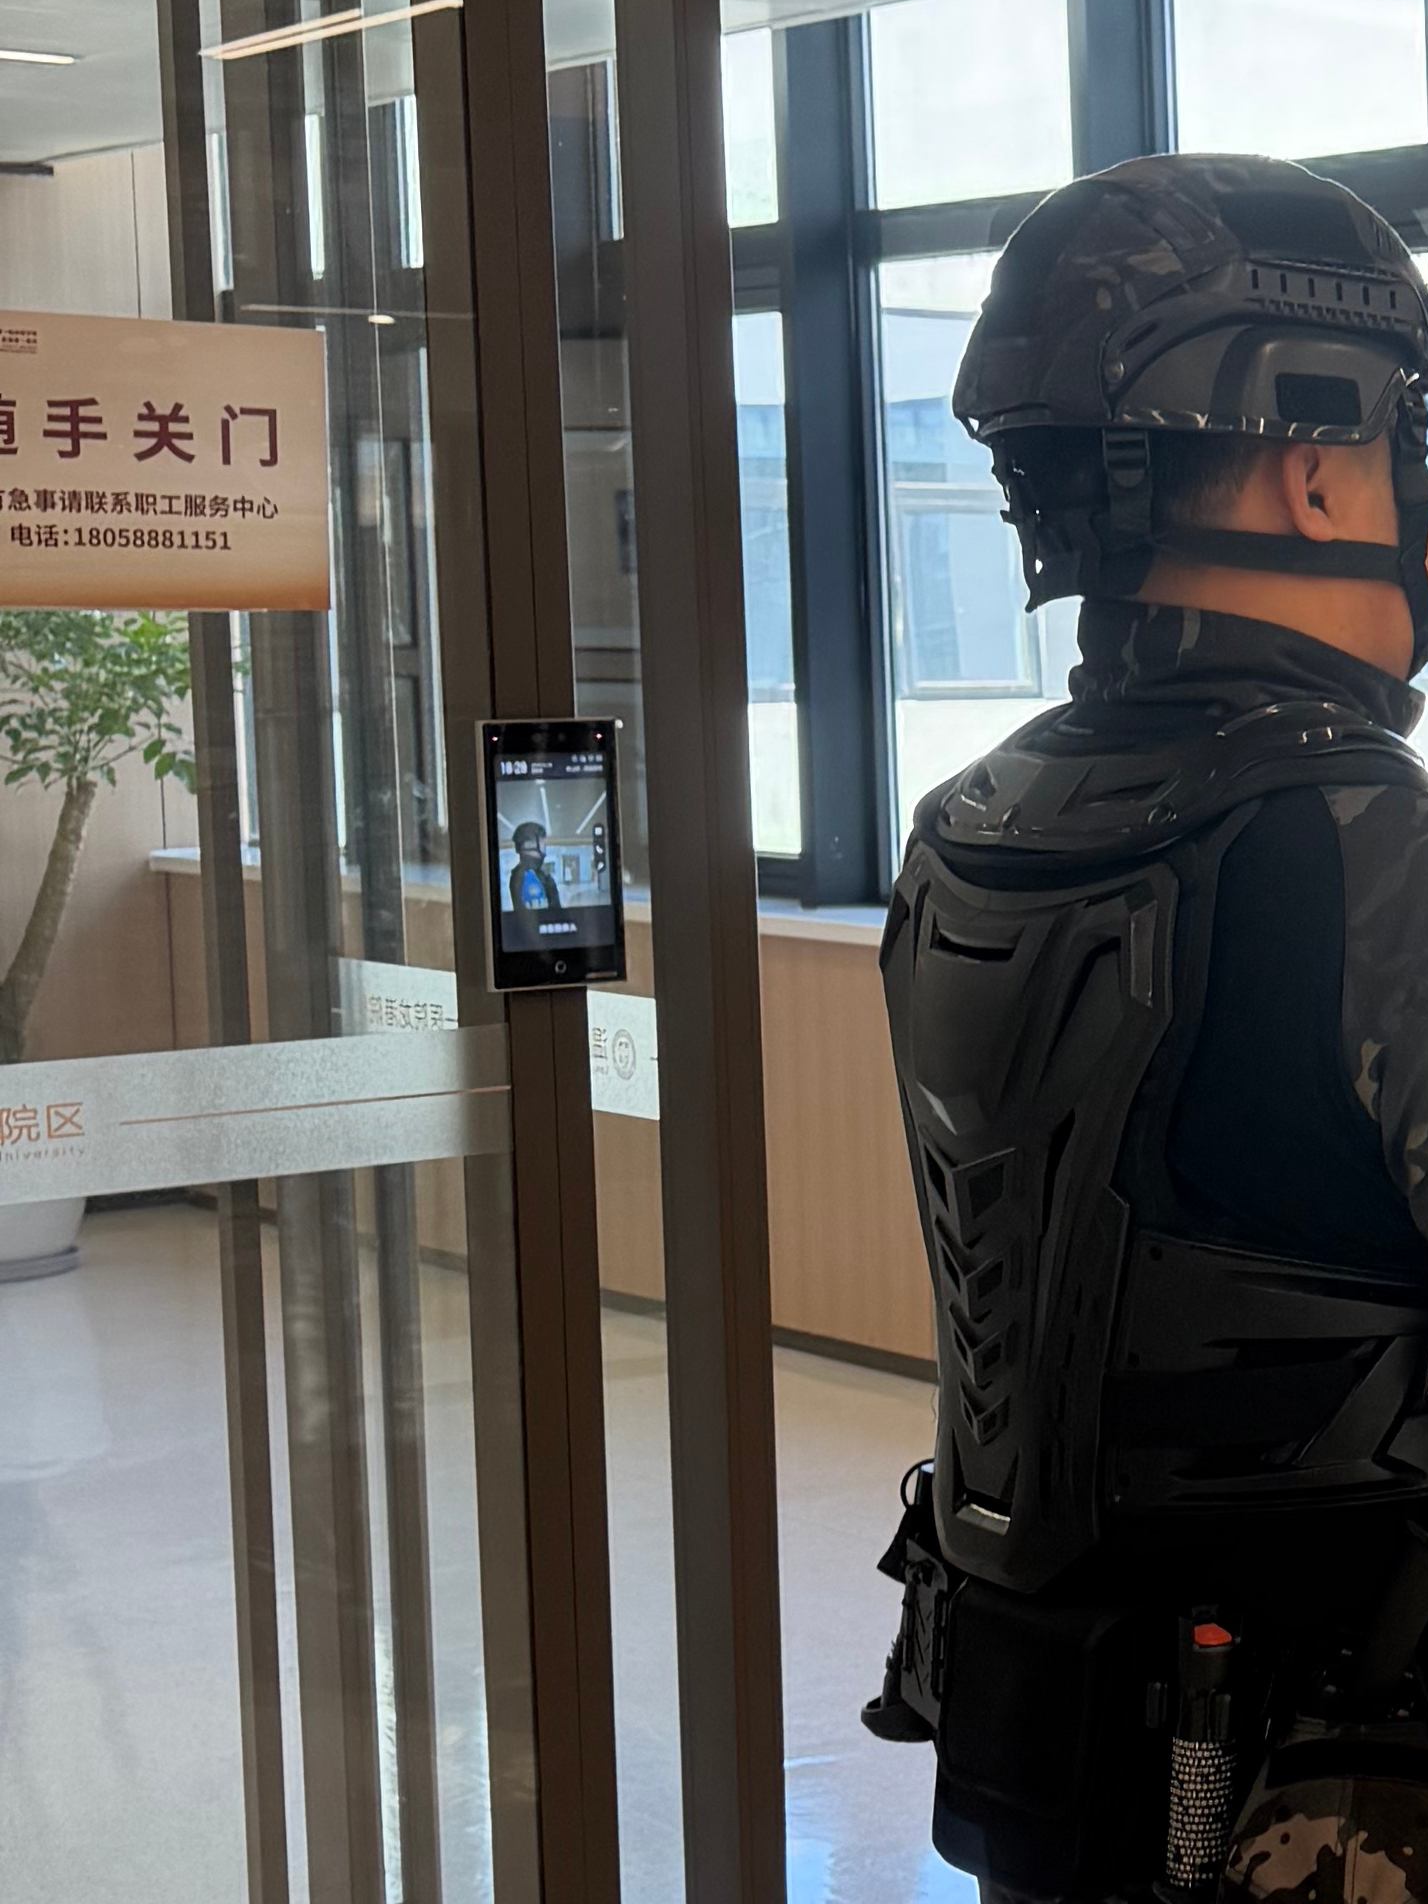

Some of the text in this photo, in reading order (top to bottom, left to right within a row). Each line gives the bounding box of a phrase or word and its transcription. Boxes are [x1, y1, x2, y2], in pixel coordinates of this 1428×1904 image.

[0, 393, 279, 467] 手关门
[0, 487, 279, 520] 急事请联系职工服务中心
[10, 523, 232, 551] 电话:18058881151
[0, 1102, 85, 1146] 院区
[0, 1145, 85, 1162] niversity
